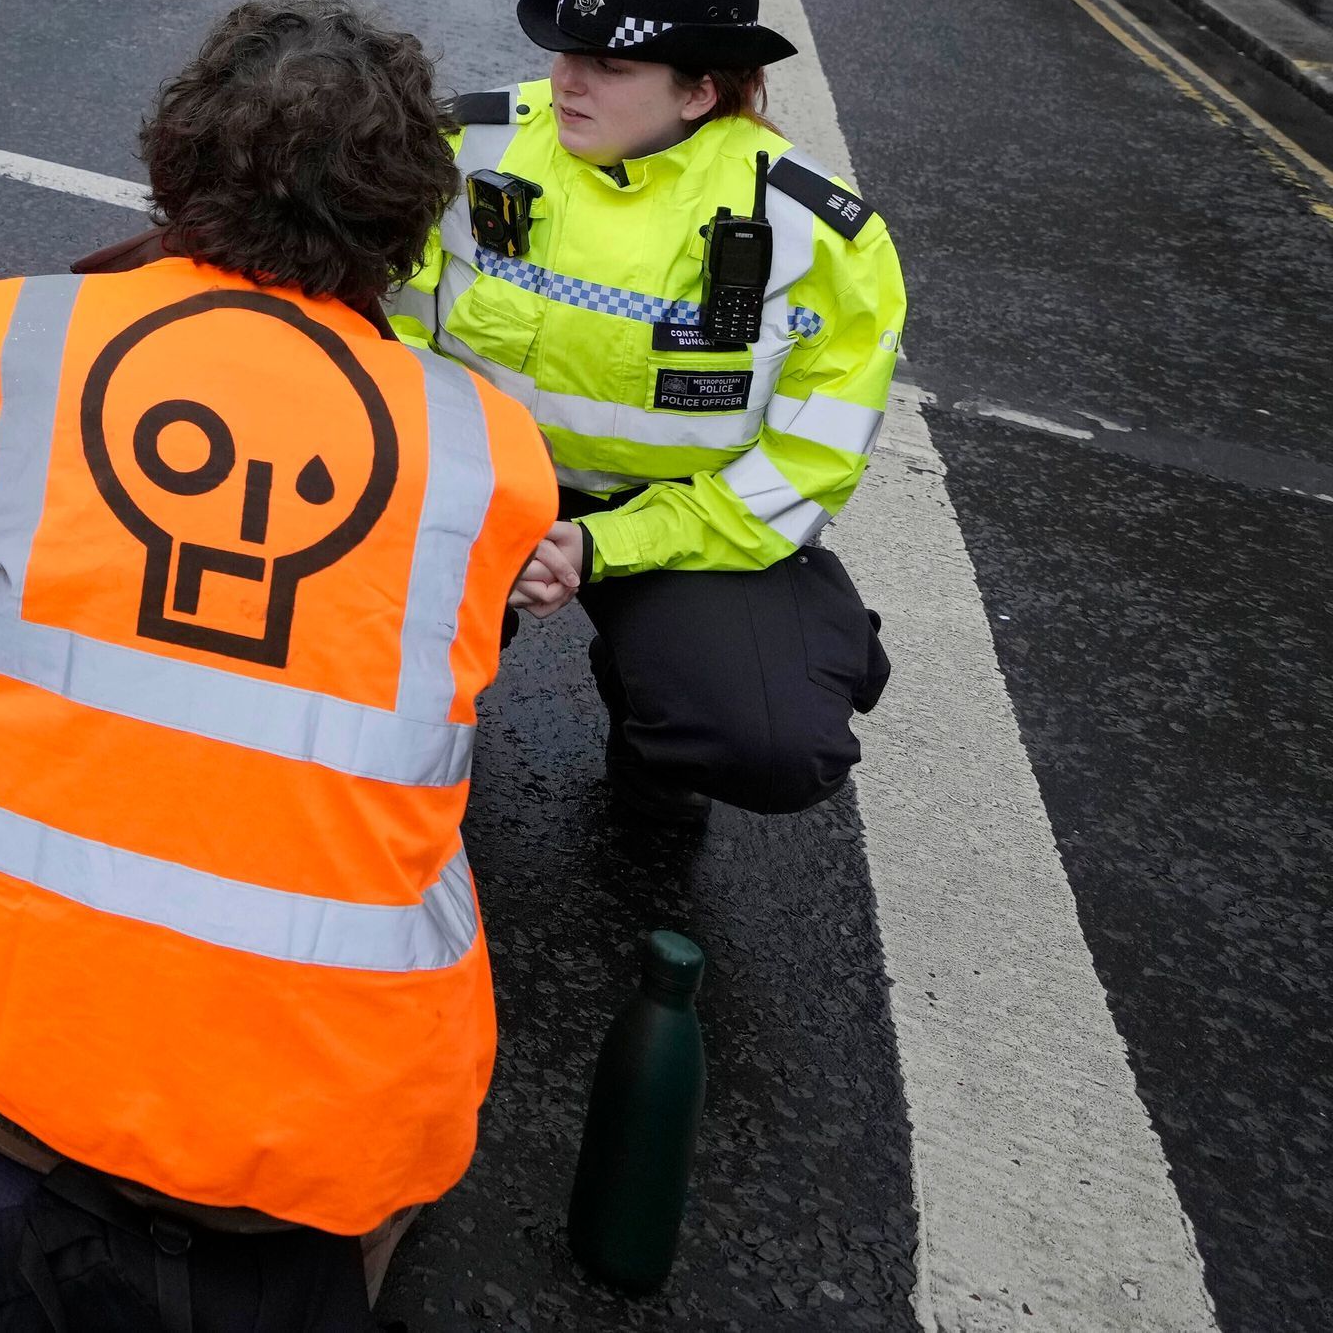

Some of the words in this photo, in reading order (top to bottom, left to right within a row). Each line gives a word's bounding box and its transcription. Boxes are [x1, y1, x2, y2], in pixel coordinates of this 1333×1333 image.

[826, 193, 846, 211] WA
[841, 200, 862, 222] 2216
[671, 330, 701, 338] CONST
[678, 338, 715, 346] BUNGAY
[699, 384, 733, 394] POLICE
[661, 395, 700, 407] POLICE
[702, 397, 743, 407] OFFICER
